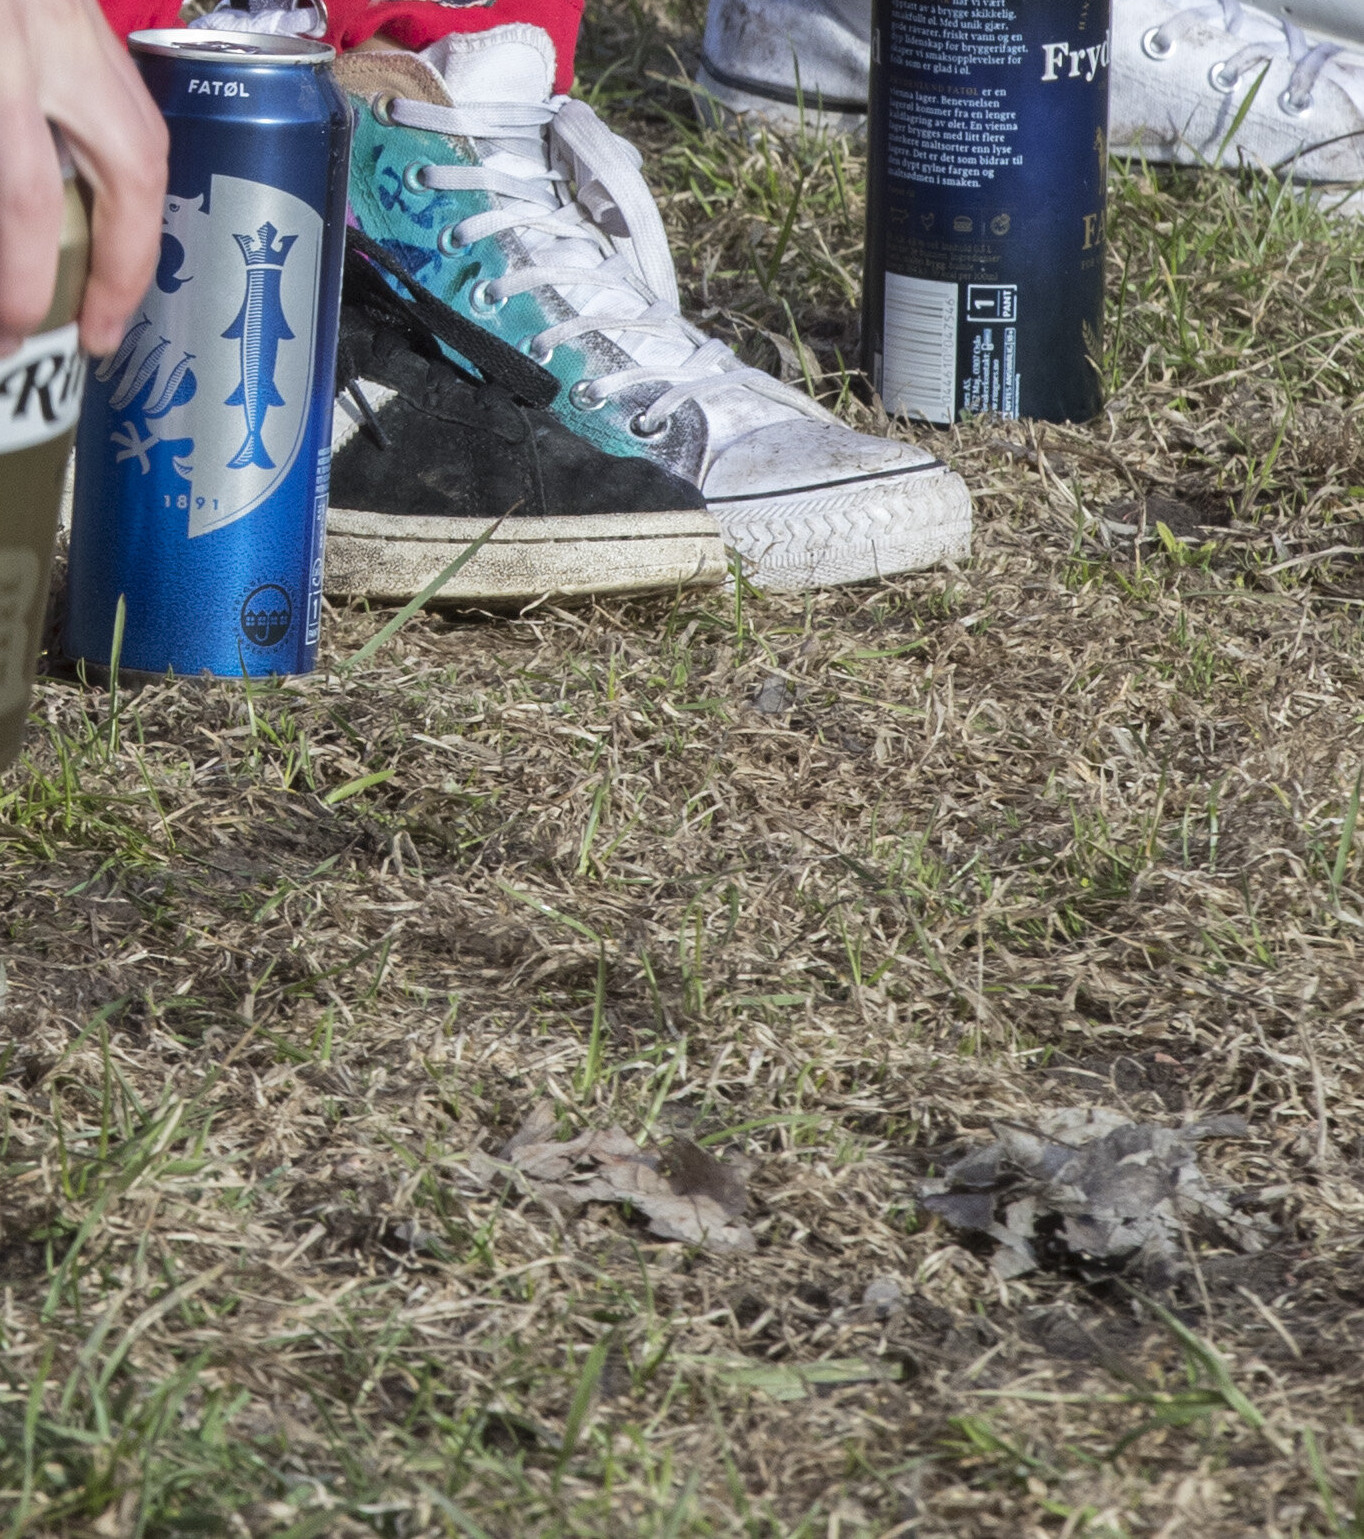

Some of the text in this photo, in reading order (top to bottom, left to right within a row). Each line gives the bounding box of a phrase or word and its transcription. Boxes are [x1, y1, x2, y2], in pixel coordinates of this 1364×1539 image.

[937, 5, 969, 20] brygge
[939, 18, 959, 28] Med
[960, 20, 983, 30] unik
[943, 28, 969, 40] friskt
[971, 33, 996, 42] vann
[997, 34, 1010, 44] og
[1011, 34, 1023, 42] en
[945, 41, 960, 51] for
[925, 50, 1006, 66] smaksopplevelser
[1007, 55, 1022, 65] for
[933, 63, 953, 74] glad
[187, 79, 251, 98] FATØL
[981, 88, 993, 97] er
[994, 88, 1007, 97] en
[940, 95, 1000, 109] Benevnelsen
[915, 102, 952, 117] kommer
[954, 107, 969, 119] fra
[971, 111, 983, 119] en
[985, 109, 1017, 122] lengre
[907, 123, 941, 140] brygges
[943, 131, 963, 141] med
[964, 132, 980, 142] litt
[982, 132, 1006, 142] flere
[934, 119, 945, 127] av
[970, 121, 983, 131] En
[985, 121, 1018, 131] vienna
[921, 140, 970, 153] maltsorter
[972, 145, 990, 154] enn
[992, 144, 1012, 156] lyse
[913, 150, 927, 160] Det
[928, 153, 939, 161] er
[940, 152, 955, 163] det
[957, 156, 978, 165] som
[979, 155, 1010, 166] bidrar
[1011, 155, 1023, 166] til
[922, 163, 946, 174] gylne
[948, 164, 980, 178] fargen
[982, 168, 995, 180] og
[942, 177, 982, 188] smaken.
[974, 299, 995, 310] 1
[1002, 290, 1012, 317] PANT
[942, 298, 955, 348] 047546
[973, 335, 981, 355] Oslo
[941, 354, 954, 405] 044610
[164, 494, 219, 511] 1891
